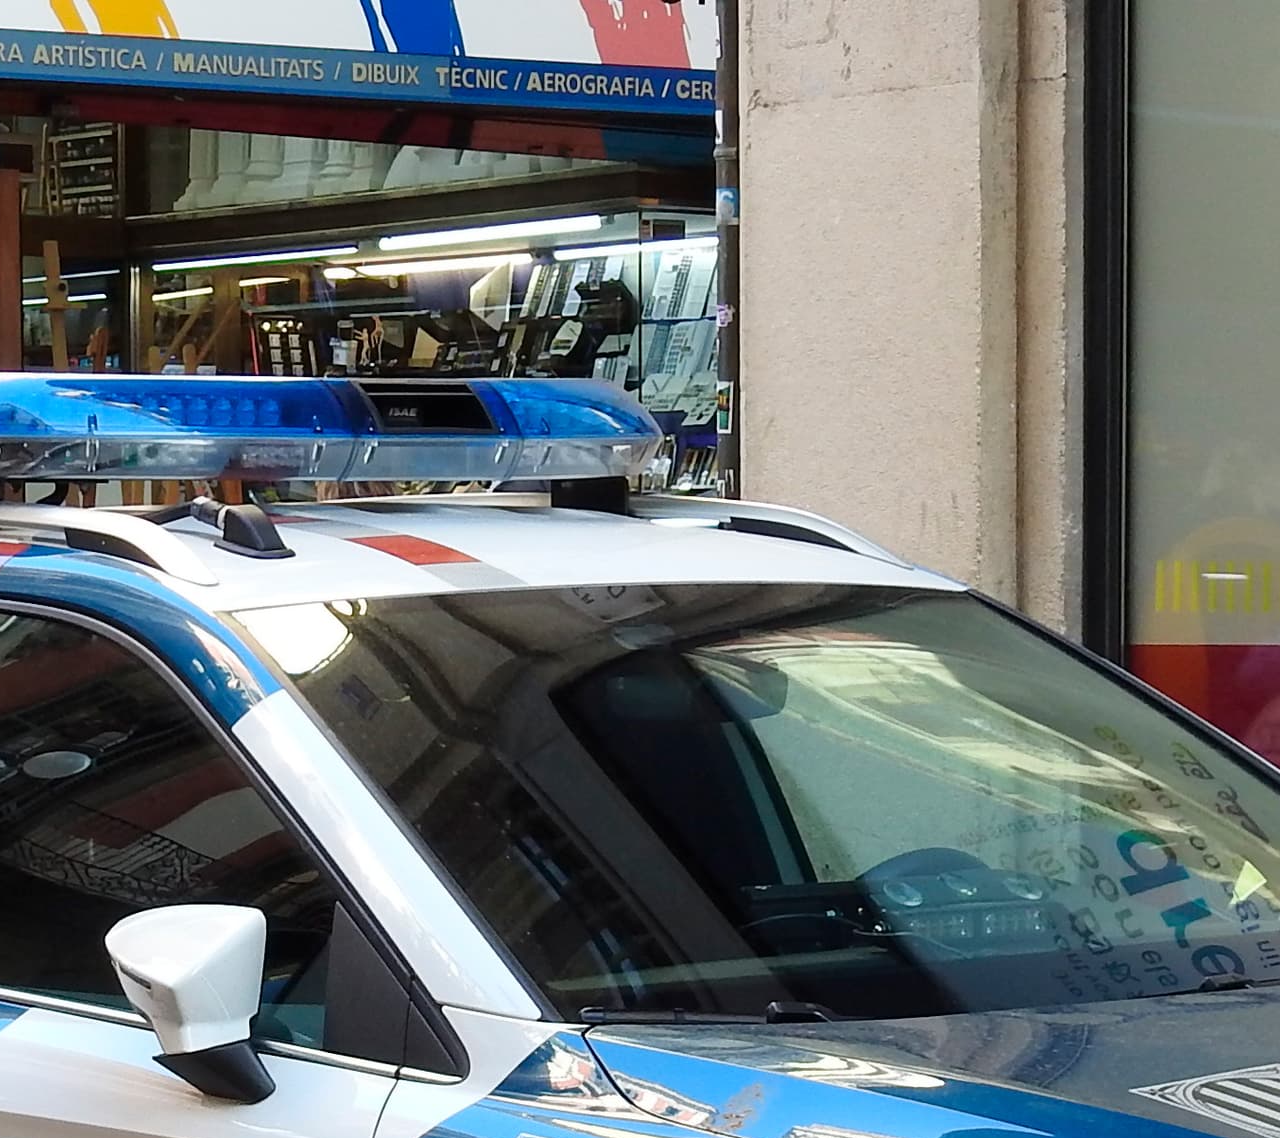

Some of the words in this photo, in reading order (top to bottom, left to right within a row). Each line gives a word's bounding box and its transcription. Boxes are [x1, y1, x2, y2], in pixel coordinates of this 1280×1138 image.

[33, 40, 147, 71] ARTÍSTICA
[173, 52, 325, 81] MANUALITATS
[352, 62, 420, 86] DIBUIX
[436, 62, 508, 91] TÈCNIC
[526, 72, 655, 98] AEROGRAFIA
[676, 79, 714, 101] CER
